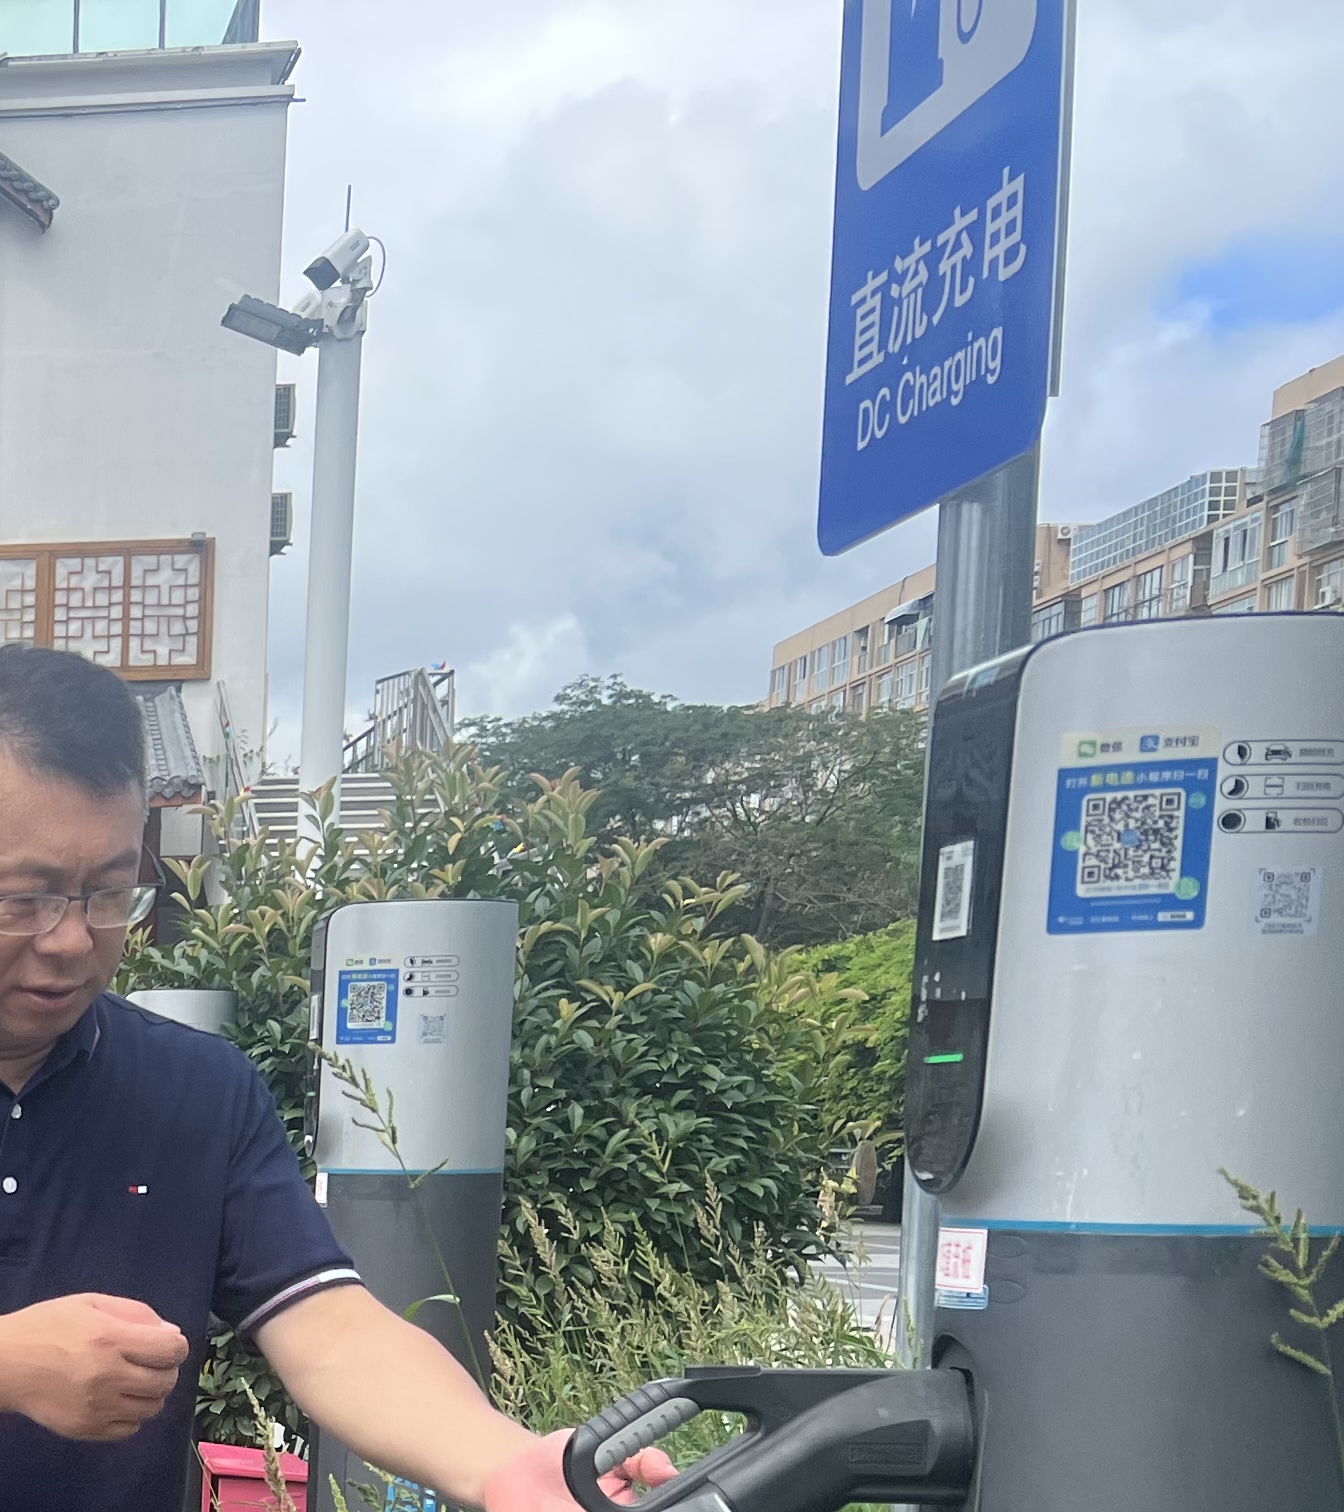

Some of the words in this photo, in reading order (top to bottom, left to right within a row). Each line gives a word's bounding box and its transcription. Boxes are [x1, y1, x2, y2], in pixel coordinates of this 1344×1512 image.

[845, 165, 1028, 386] 直流充电
[856, 387, 890, 452] DC
[896, 326, 1004, 425] Charging
